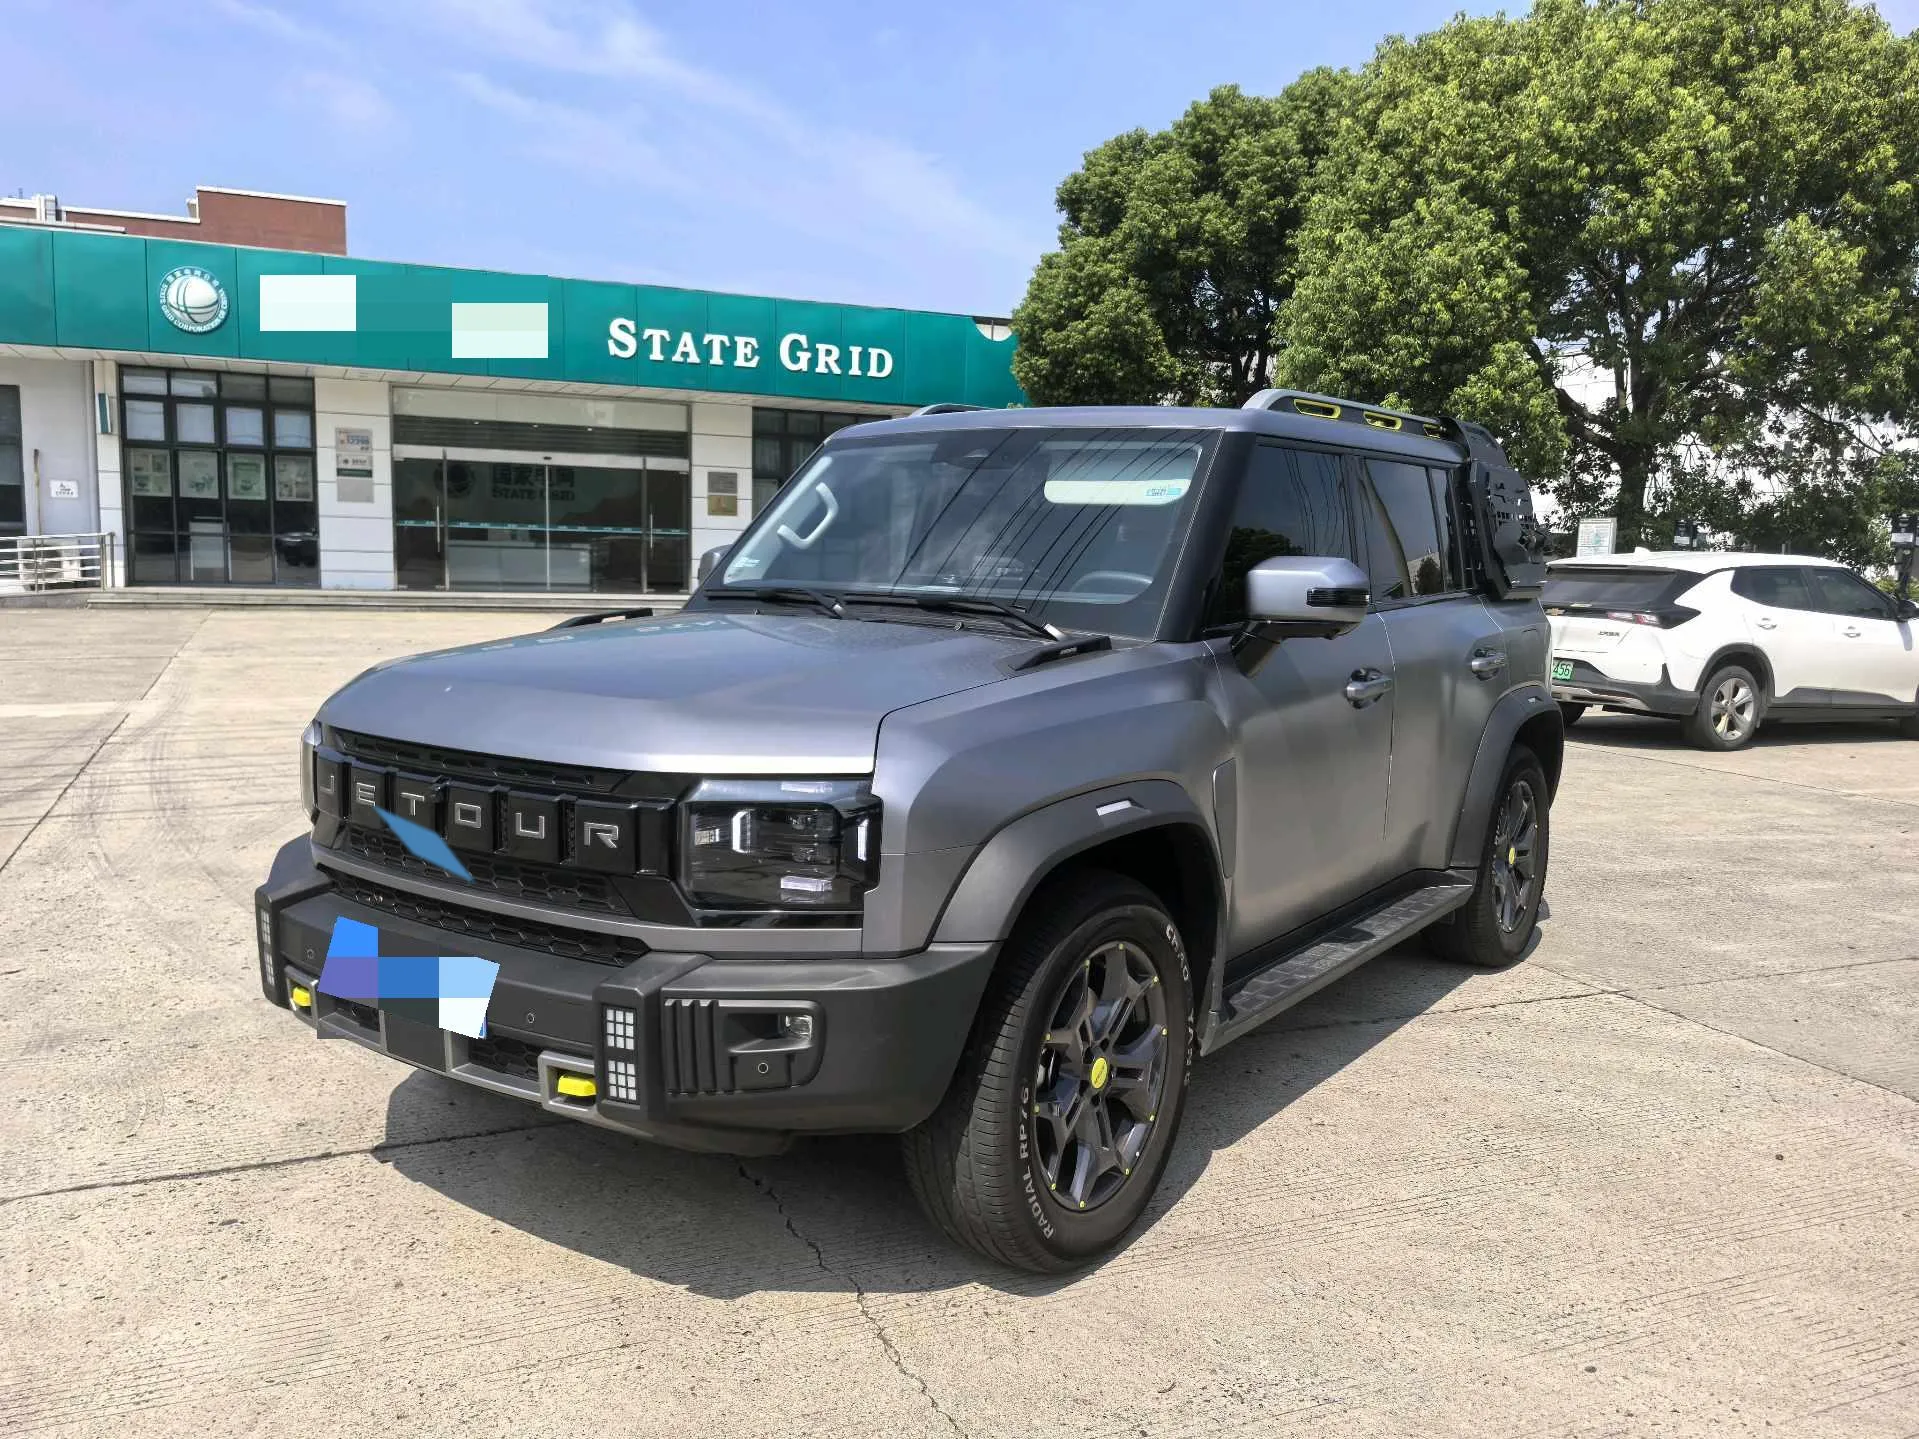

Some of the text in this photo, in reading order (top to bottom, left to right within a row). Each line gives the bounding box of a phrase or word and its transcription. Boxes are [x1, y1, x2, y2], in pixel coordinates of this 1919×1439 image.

[607, 317, 894, 378] STATE GRID
[319, 775, 619, 848] JETOUR
[1022, 1165, 1054, 1239] RADIAL
